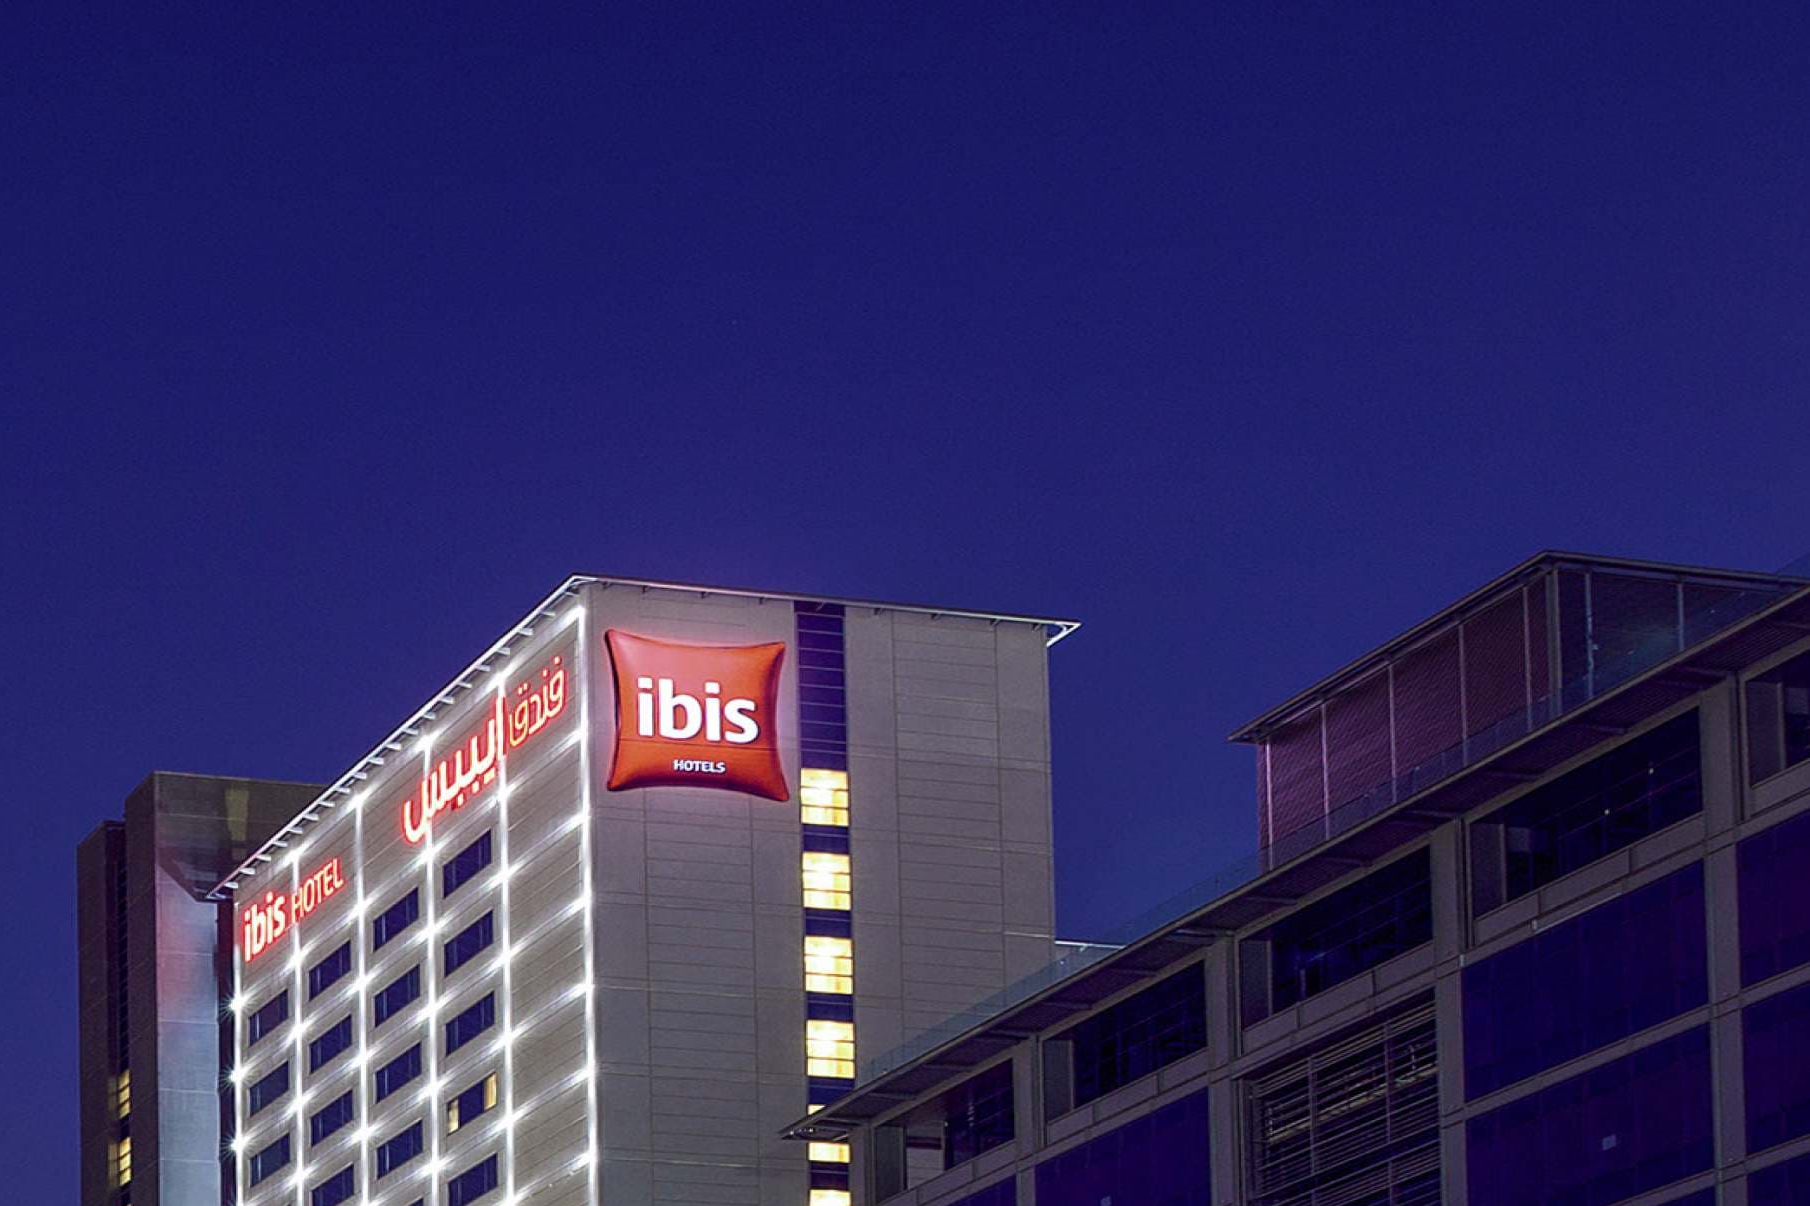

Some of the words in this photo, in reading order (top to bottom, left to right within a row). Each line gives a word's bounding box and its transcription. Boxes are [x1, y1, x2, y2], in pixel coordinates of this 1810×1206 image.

[508, 656, 565, 746] فندق
[637, 677, 759, 744] ibis
[673, 758, 726, 773] HOTELS
[244, 891, 286, 962] ibis
[291, 858, 344, 924] HOTEL
